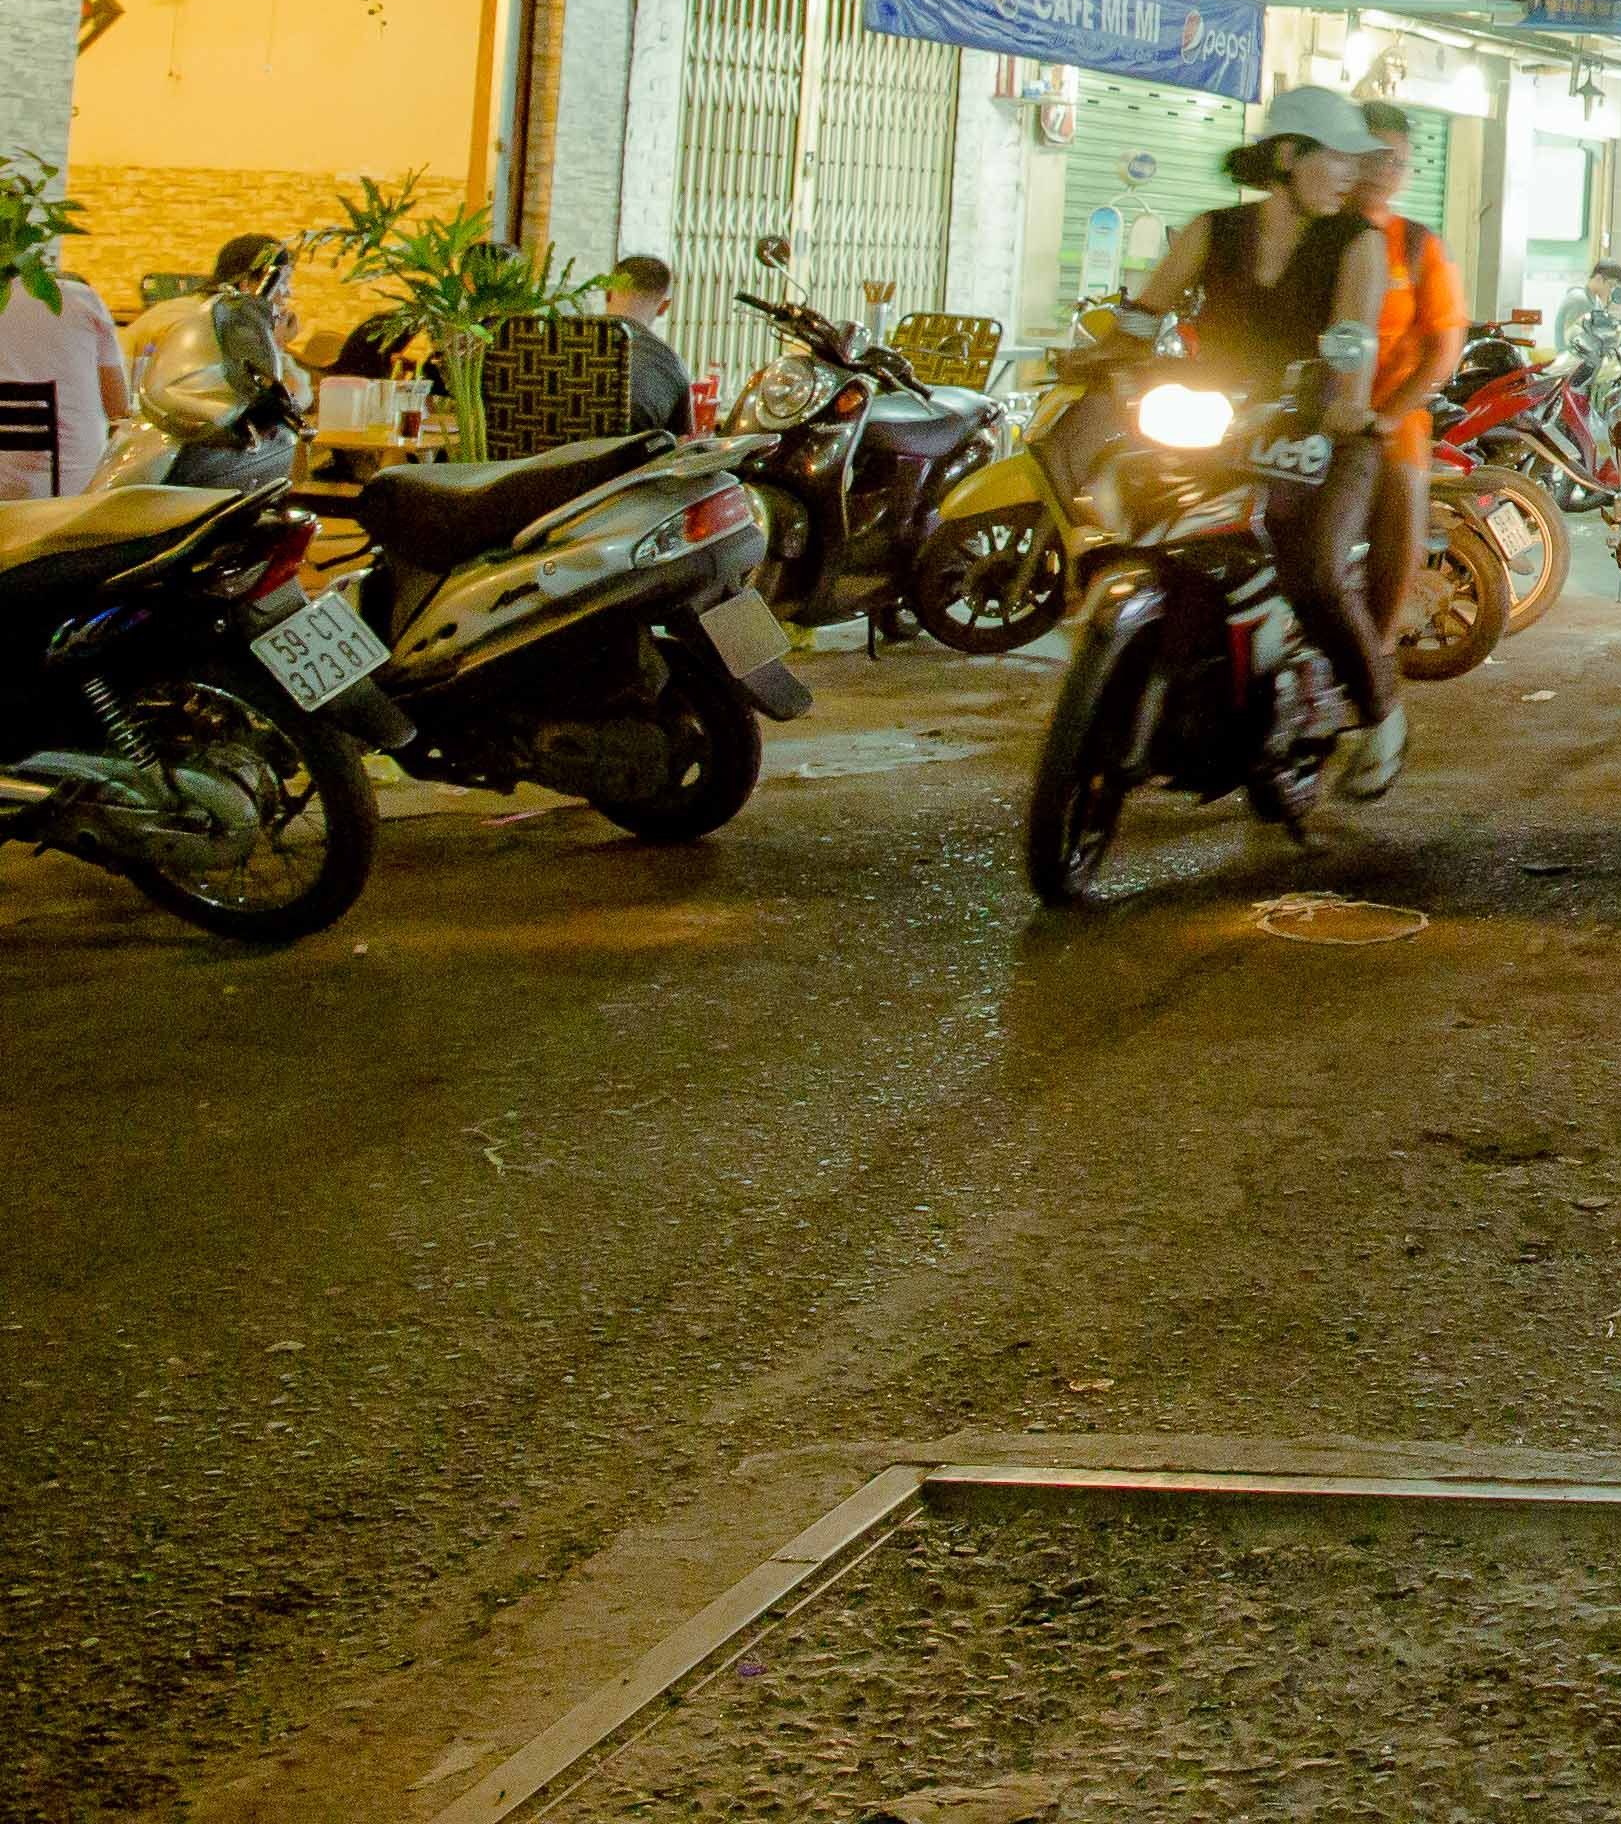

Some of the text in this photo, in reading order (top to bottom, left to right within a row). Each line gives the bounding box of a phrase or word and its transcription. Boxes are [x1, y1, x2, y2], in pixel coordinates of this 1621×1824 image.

[1136, 0, 1160, 43] MI
[1204, 27, 1254, 67] pepsi
[268, 606, 343, 664] 59-C1
